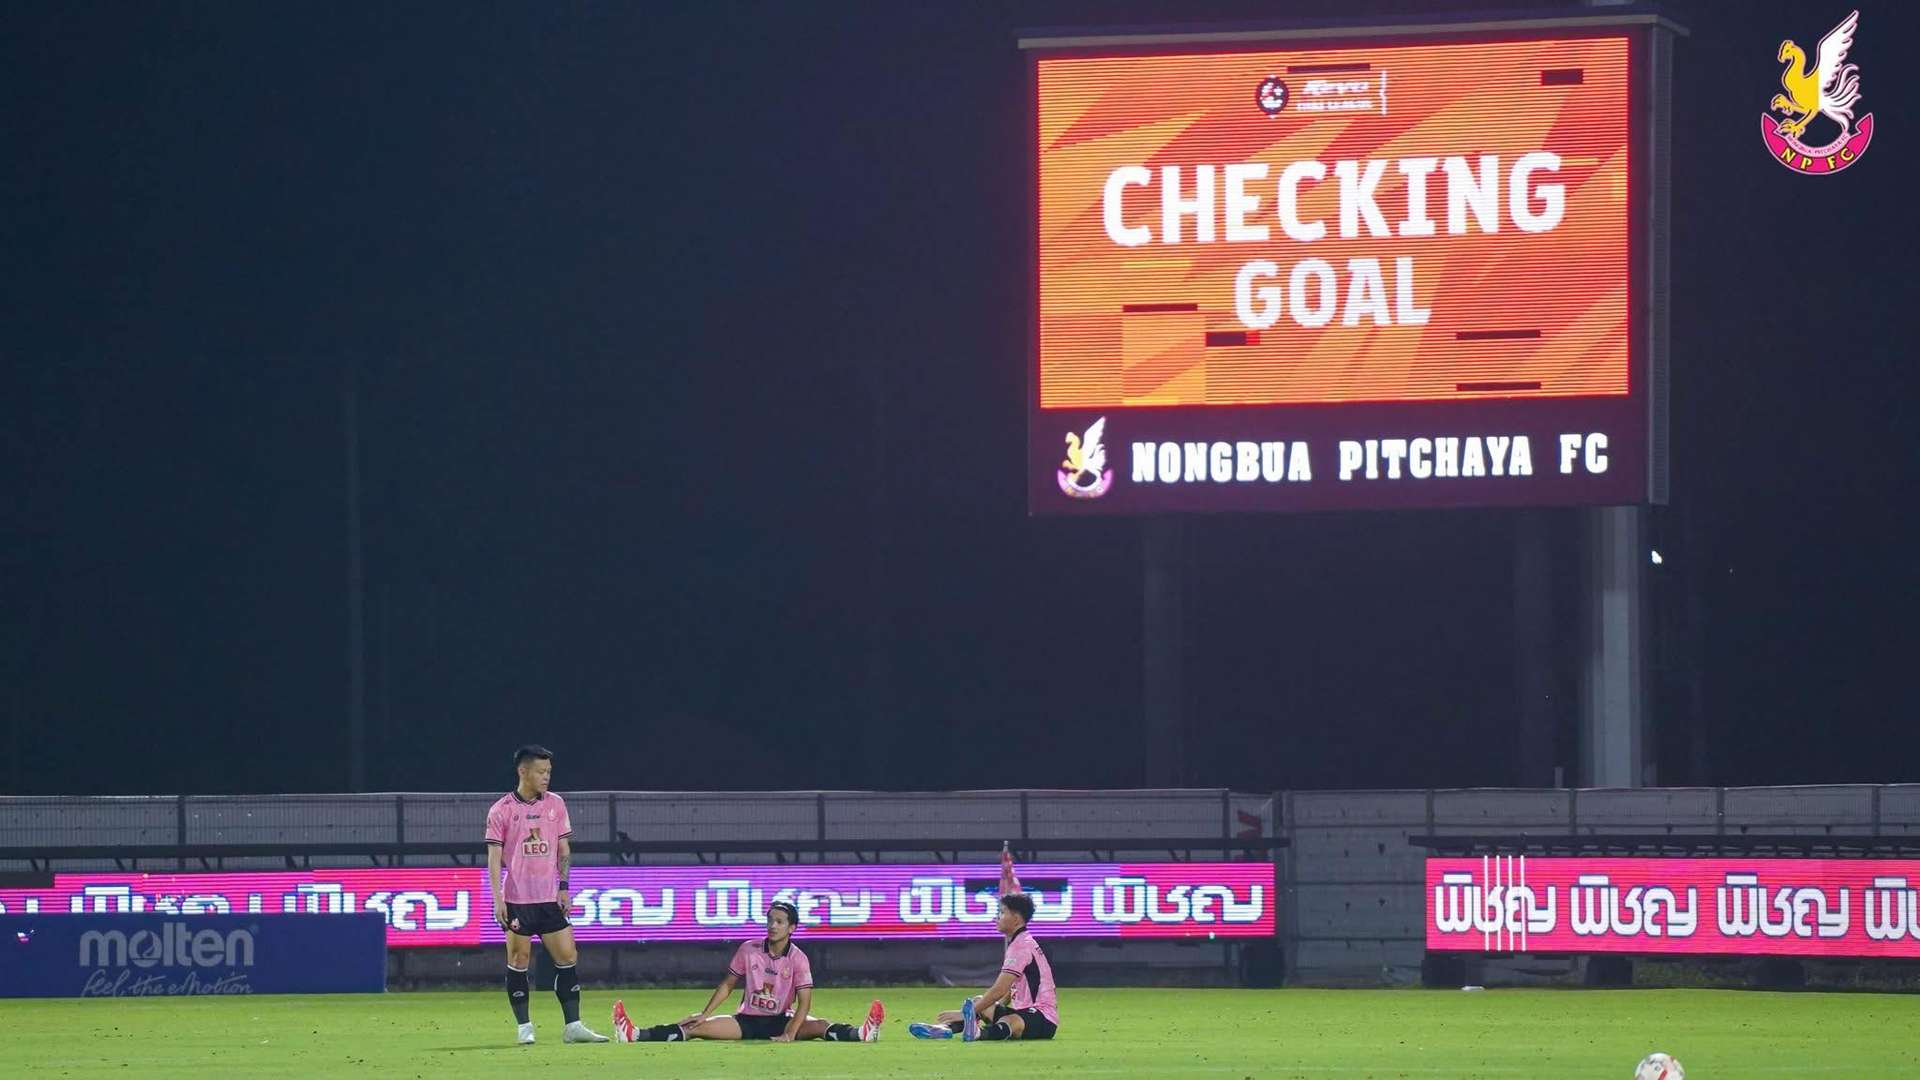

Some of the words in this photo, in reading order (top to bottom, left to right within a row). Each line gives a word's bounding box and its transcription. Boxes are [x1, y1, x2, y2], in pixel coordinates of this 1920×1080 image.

[1103, 152, 1566, 247] CHECKING
[1234, 256, 1431, 329] GOAL
[1132, 441, 1312, 483] NONGBUA
[1339, 436, 1533, 480] PITCHAYA
[1560, 433, 1608, 474] FC
[523, 843, 548, 855] LEO
[1093, 877, 1263, 921] พิชญ
[1571, 875, 1697, 936] พิชญ
[1717, 875, 1849, 937] พิชญ
[79, 922, 254, 968] molten
[751, 996, 776, 1010] LEO
